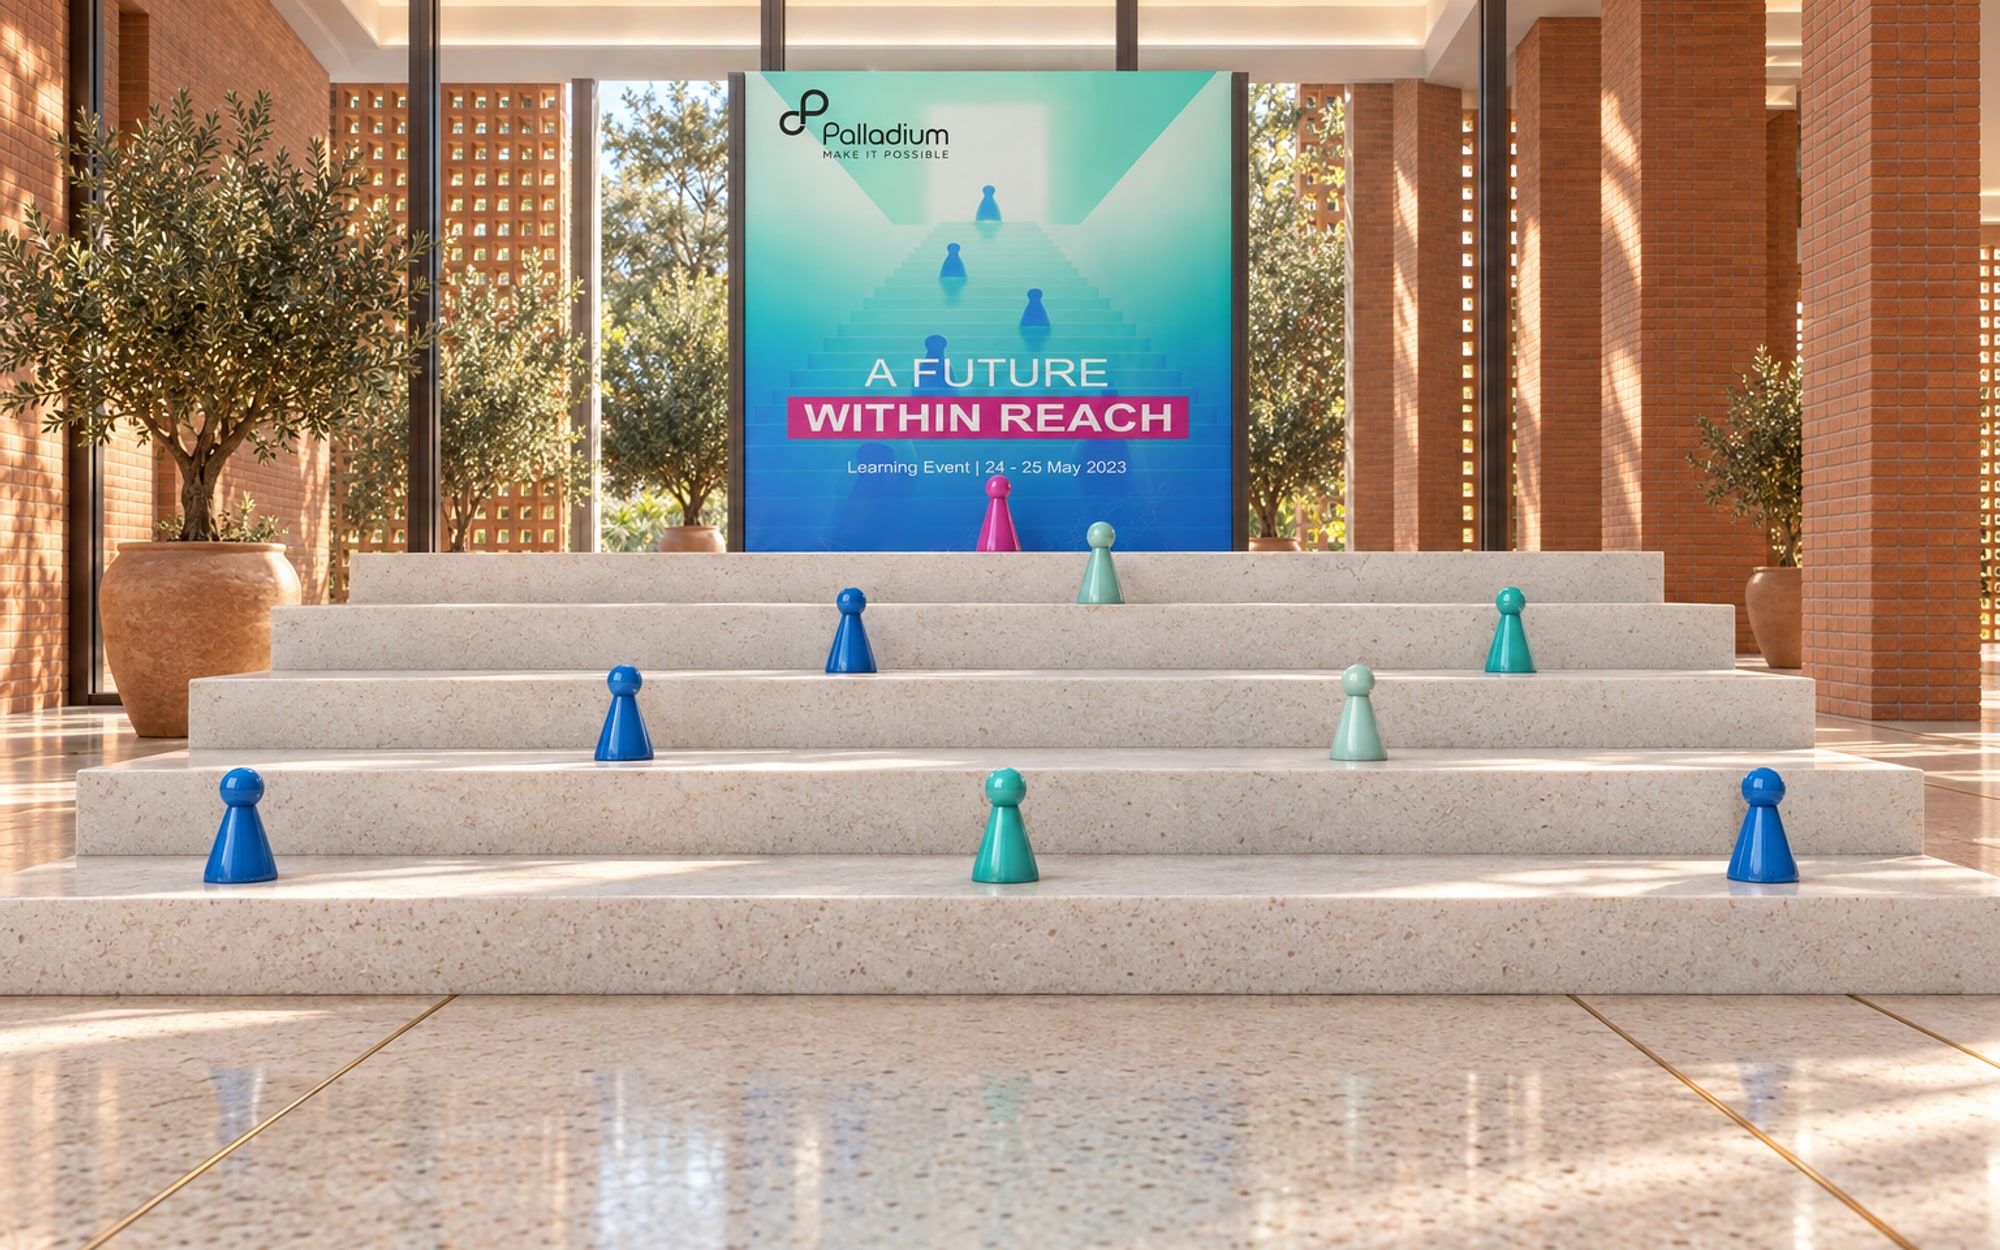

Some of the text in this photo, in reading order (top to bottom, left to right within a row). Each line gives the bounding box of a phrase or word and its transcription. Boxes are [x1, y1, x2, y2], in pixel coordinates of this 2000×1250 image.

[823, 122, 949, 146] Palladium
[823, 150, 949, 159] MAKE IT POSSIBLE
[864, 358, 1109, 388] A FUTURE
[803, 403, 1172, 433] WITHIN REACH
[847, 460, 918, 477] Learning
[923, 460, 971, 474] Event
[985, 460, 1006, 474] 24
[1022, 460, 1043, 474] 25
[1047, 460, 1082, 477] May
[1086, 460, 1127, 474] 2023
